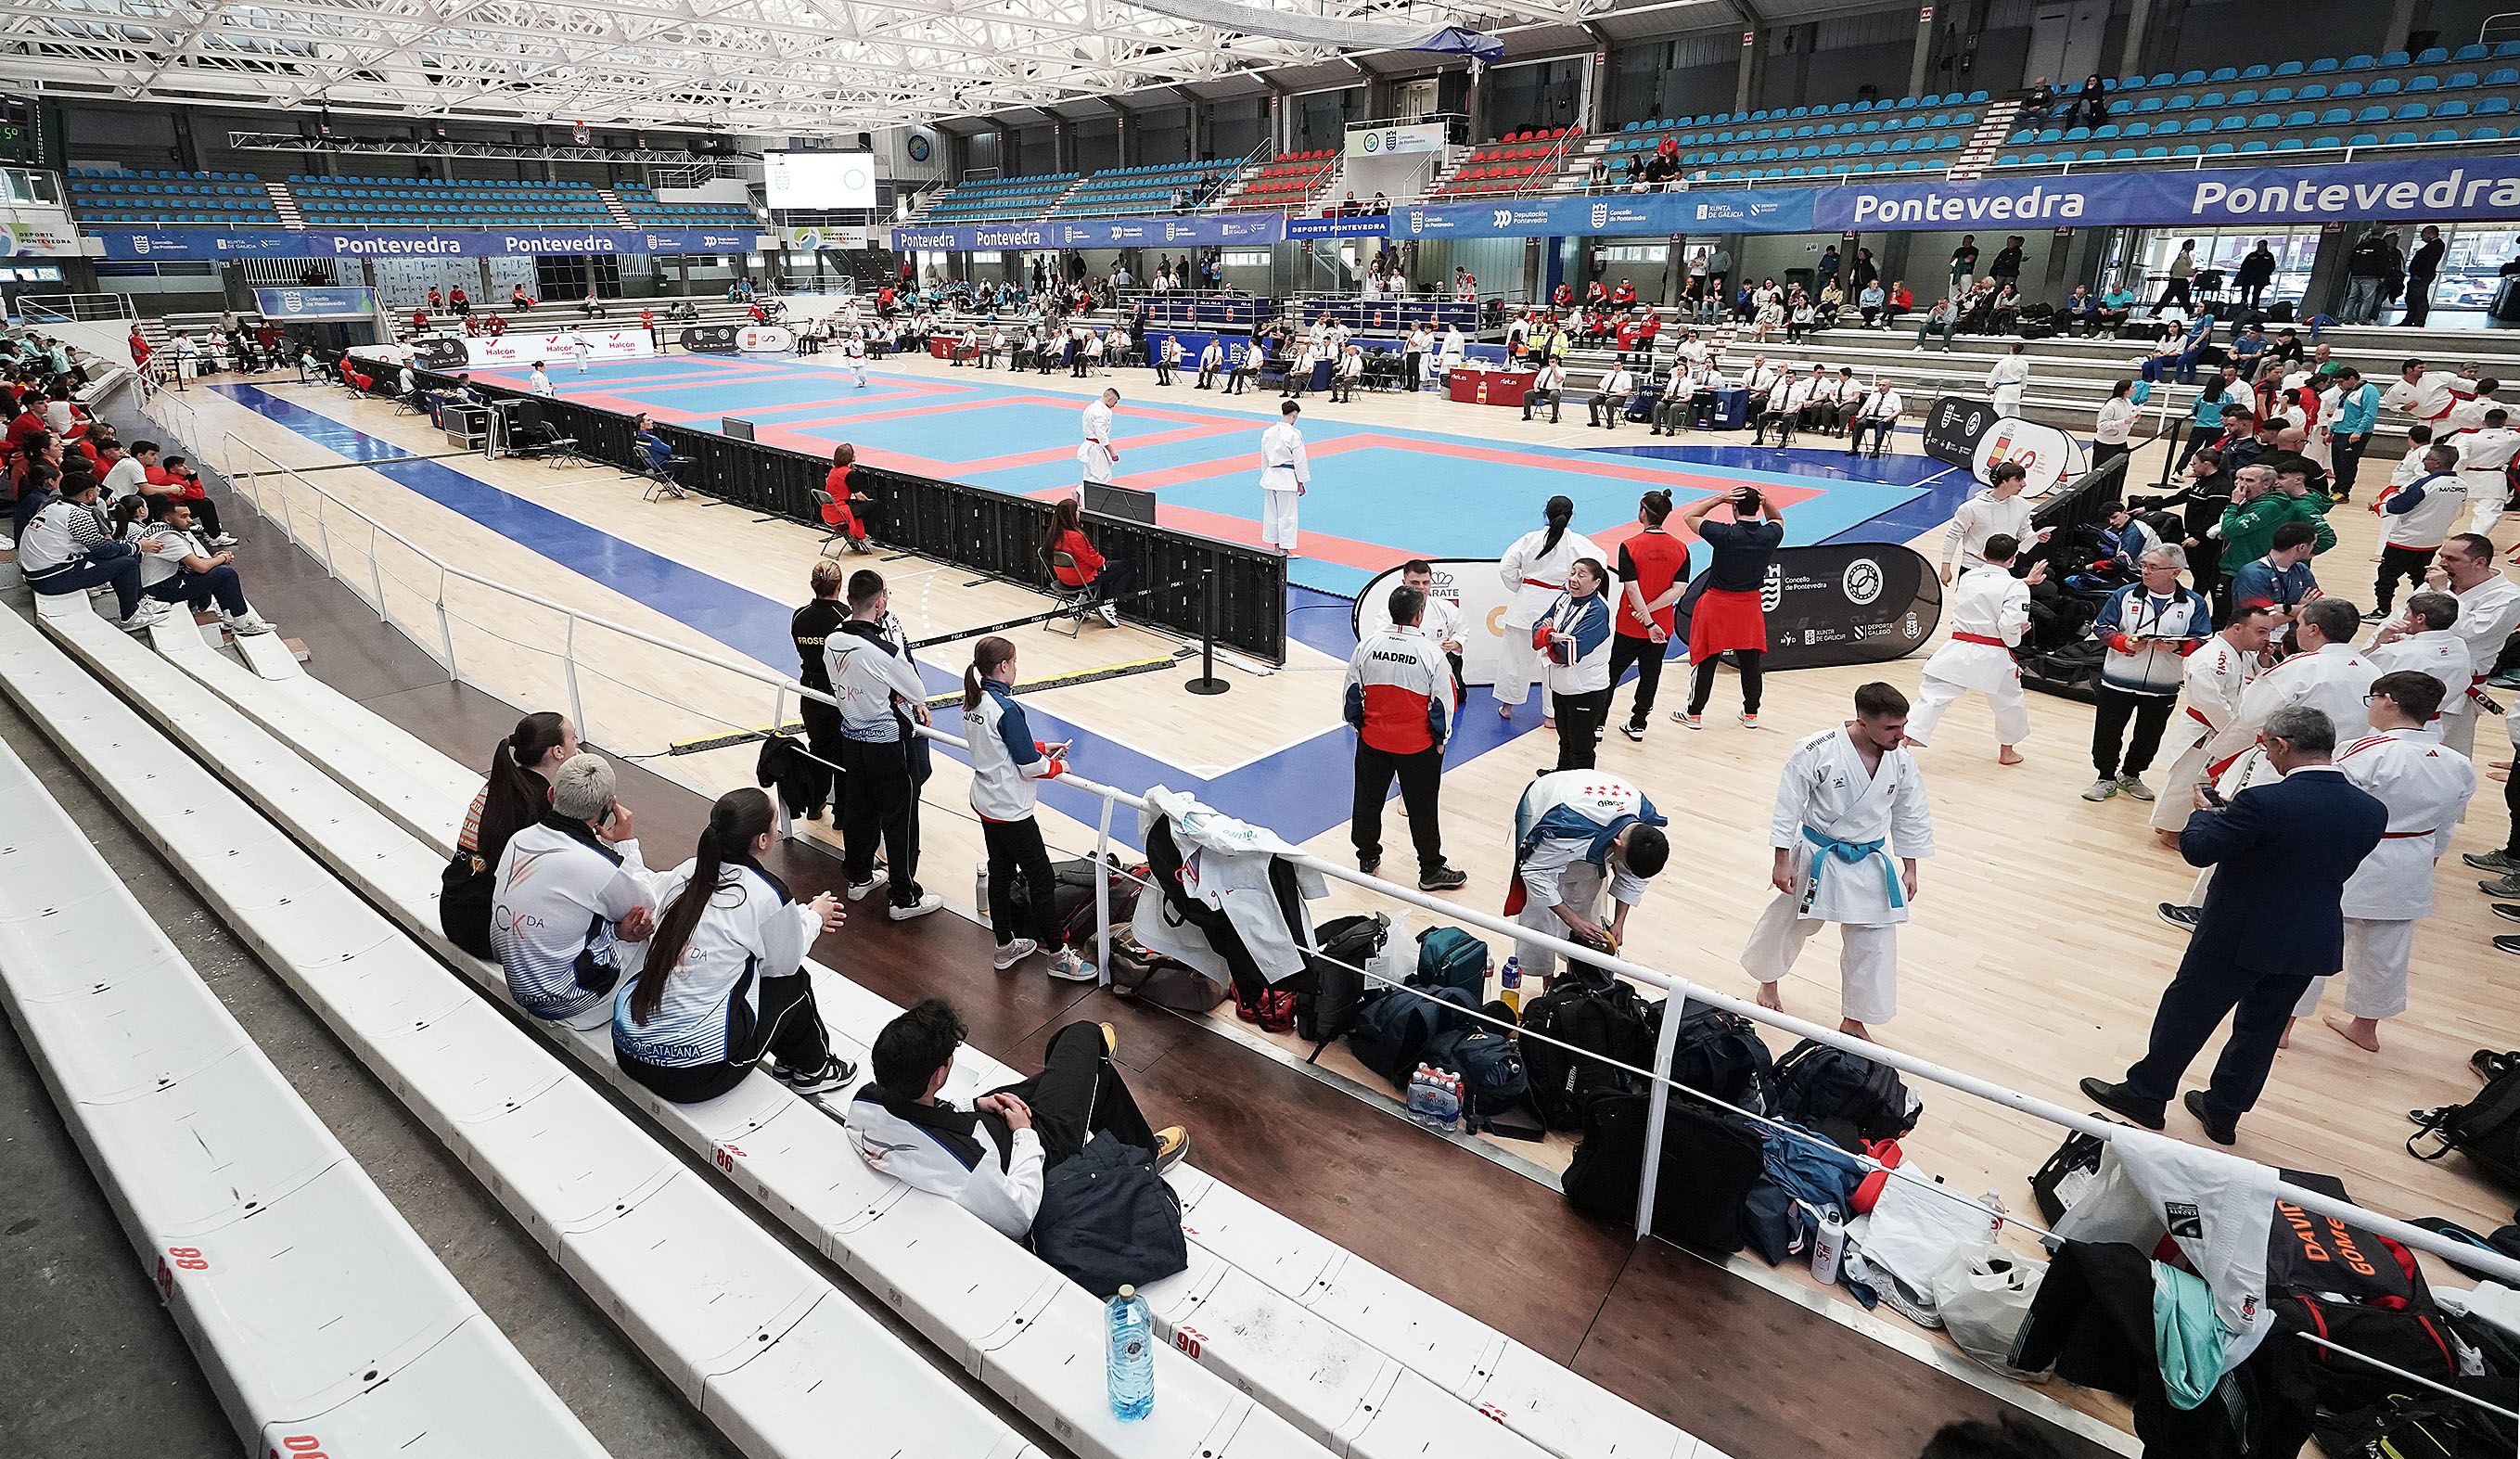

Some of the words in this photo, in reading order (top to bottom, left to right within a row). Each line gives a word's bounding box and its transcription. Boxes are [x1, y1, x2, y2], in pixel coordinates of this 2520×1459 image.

[2192, 168, 2520, 214] Pontevedra
[1854, 186, 2085, 223] Pontevedra
[1514, 210, 1549, 218] Deputación
[1514, 216, 1549, 224] Pontevedra
[1291, 224, 1327, 233] DEPORTE
[1330, 223, 1387, 232] PONTEVEDRA
[505, 234, 613, 252] Pontevedra
[901, 231, 955, 248] Pontevedra
[977, 228, 1041, 246] Pontevedra
[333, 235, 462, 254] Pontevedra
[1500, 377, 1517, 385] rfek.es
[1717, 401, 1724, 412] 1
[1784, 575, 1810, 584] Concello
[1429, 588, 1460, 597] RATE
[1794, 582, 1827, 591] Pontevedra
[951, 633, 964, 641] FGK
[1823, 633, 1846, 642] GALICIA
[1372, 650, 1417, 665] MADRID
[645, 1045, 701, 1058] CATALANA
[716, 1148, 734, 1173] 86
[169, 1247, 209, 1271] 88
[1176, 1331, 1201, 1360] 90
